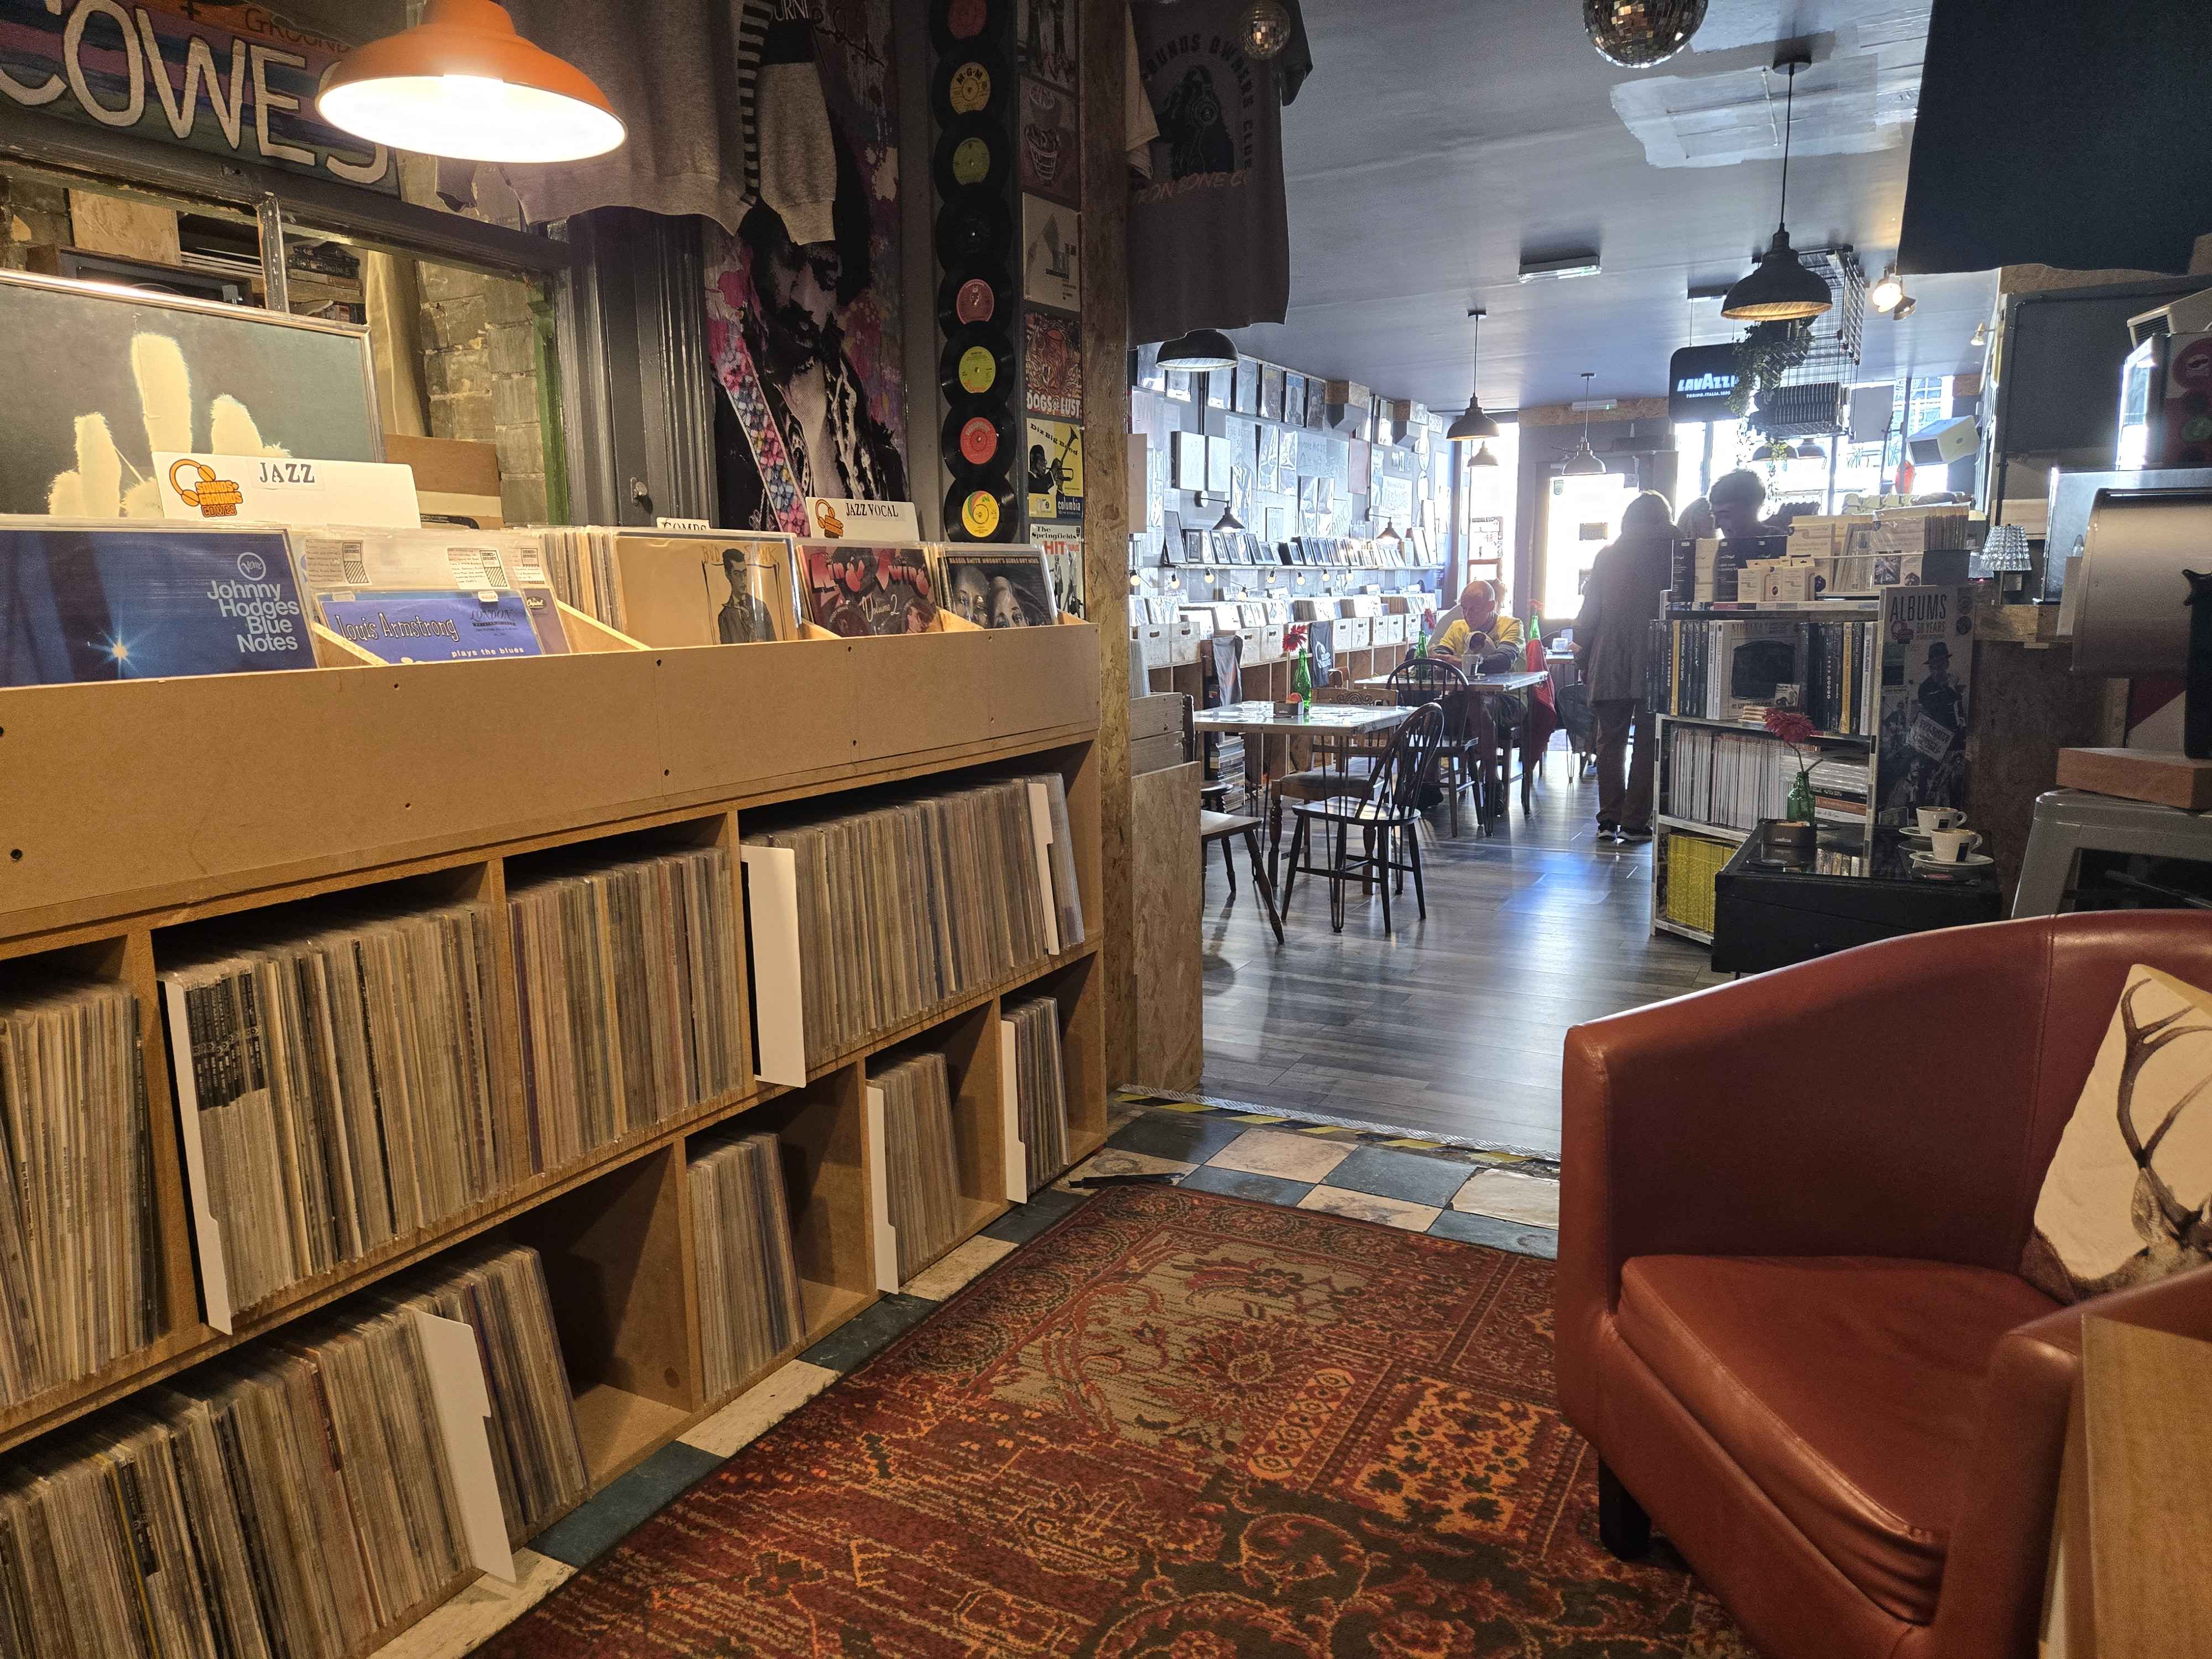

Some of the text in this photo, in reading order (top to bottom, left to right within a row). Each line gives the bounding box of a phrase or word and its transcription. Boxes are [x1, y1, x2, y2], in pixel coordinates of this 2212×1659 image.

[1027, 391, 1052, 413] DOGS
[1061, 397, 1081, 416] LUST
[1030, 423, 1078, 456] Diz Big Band
[259, 462, 315, 483] JAZZ
[199, 492, 243, 504] GROUNDS
[1058, 496, 1081, 511] columbia
[202, 504, 237, 517] COWES
[846, 503, 899, 517] JAZZ VOCAL
[1031, 532, 1076, 540] Springfields
[1044, 540, 1065, 555] HIT
[206, 580, 280, 602] Johnny
[218, 597, 300, 619] Hodges
[890, 594, 900, 616] 2
[1890, 594, 1947, 623] ALBUMS
[246, 615, 293, 634] Blue
[469, 609, 514, 622] LONDON
[335, 611, 461, 642] Louis Armstrong
[1926, 621, 1946, 634] YEARS
[236, 633, 298, 653] Notes
[451, 646, 524, 659] plays the blues
